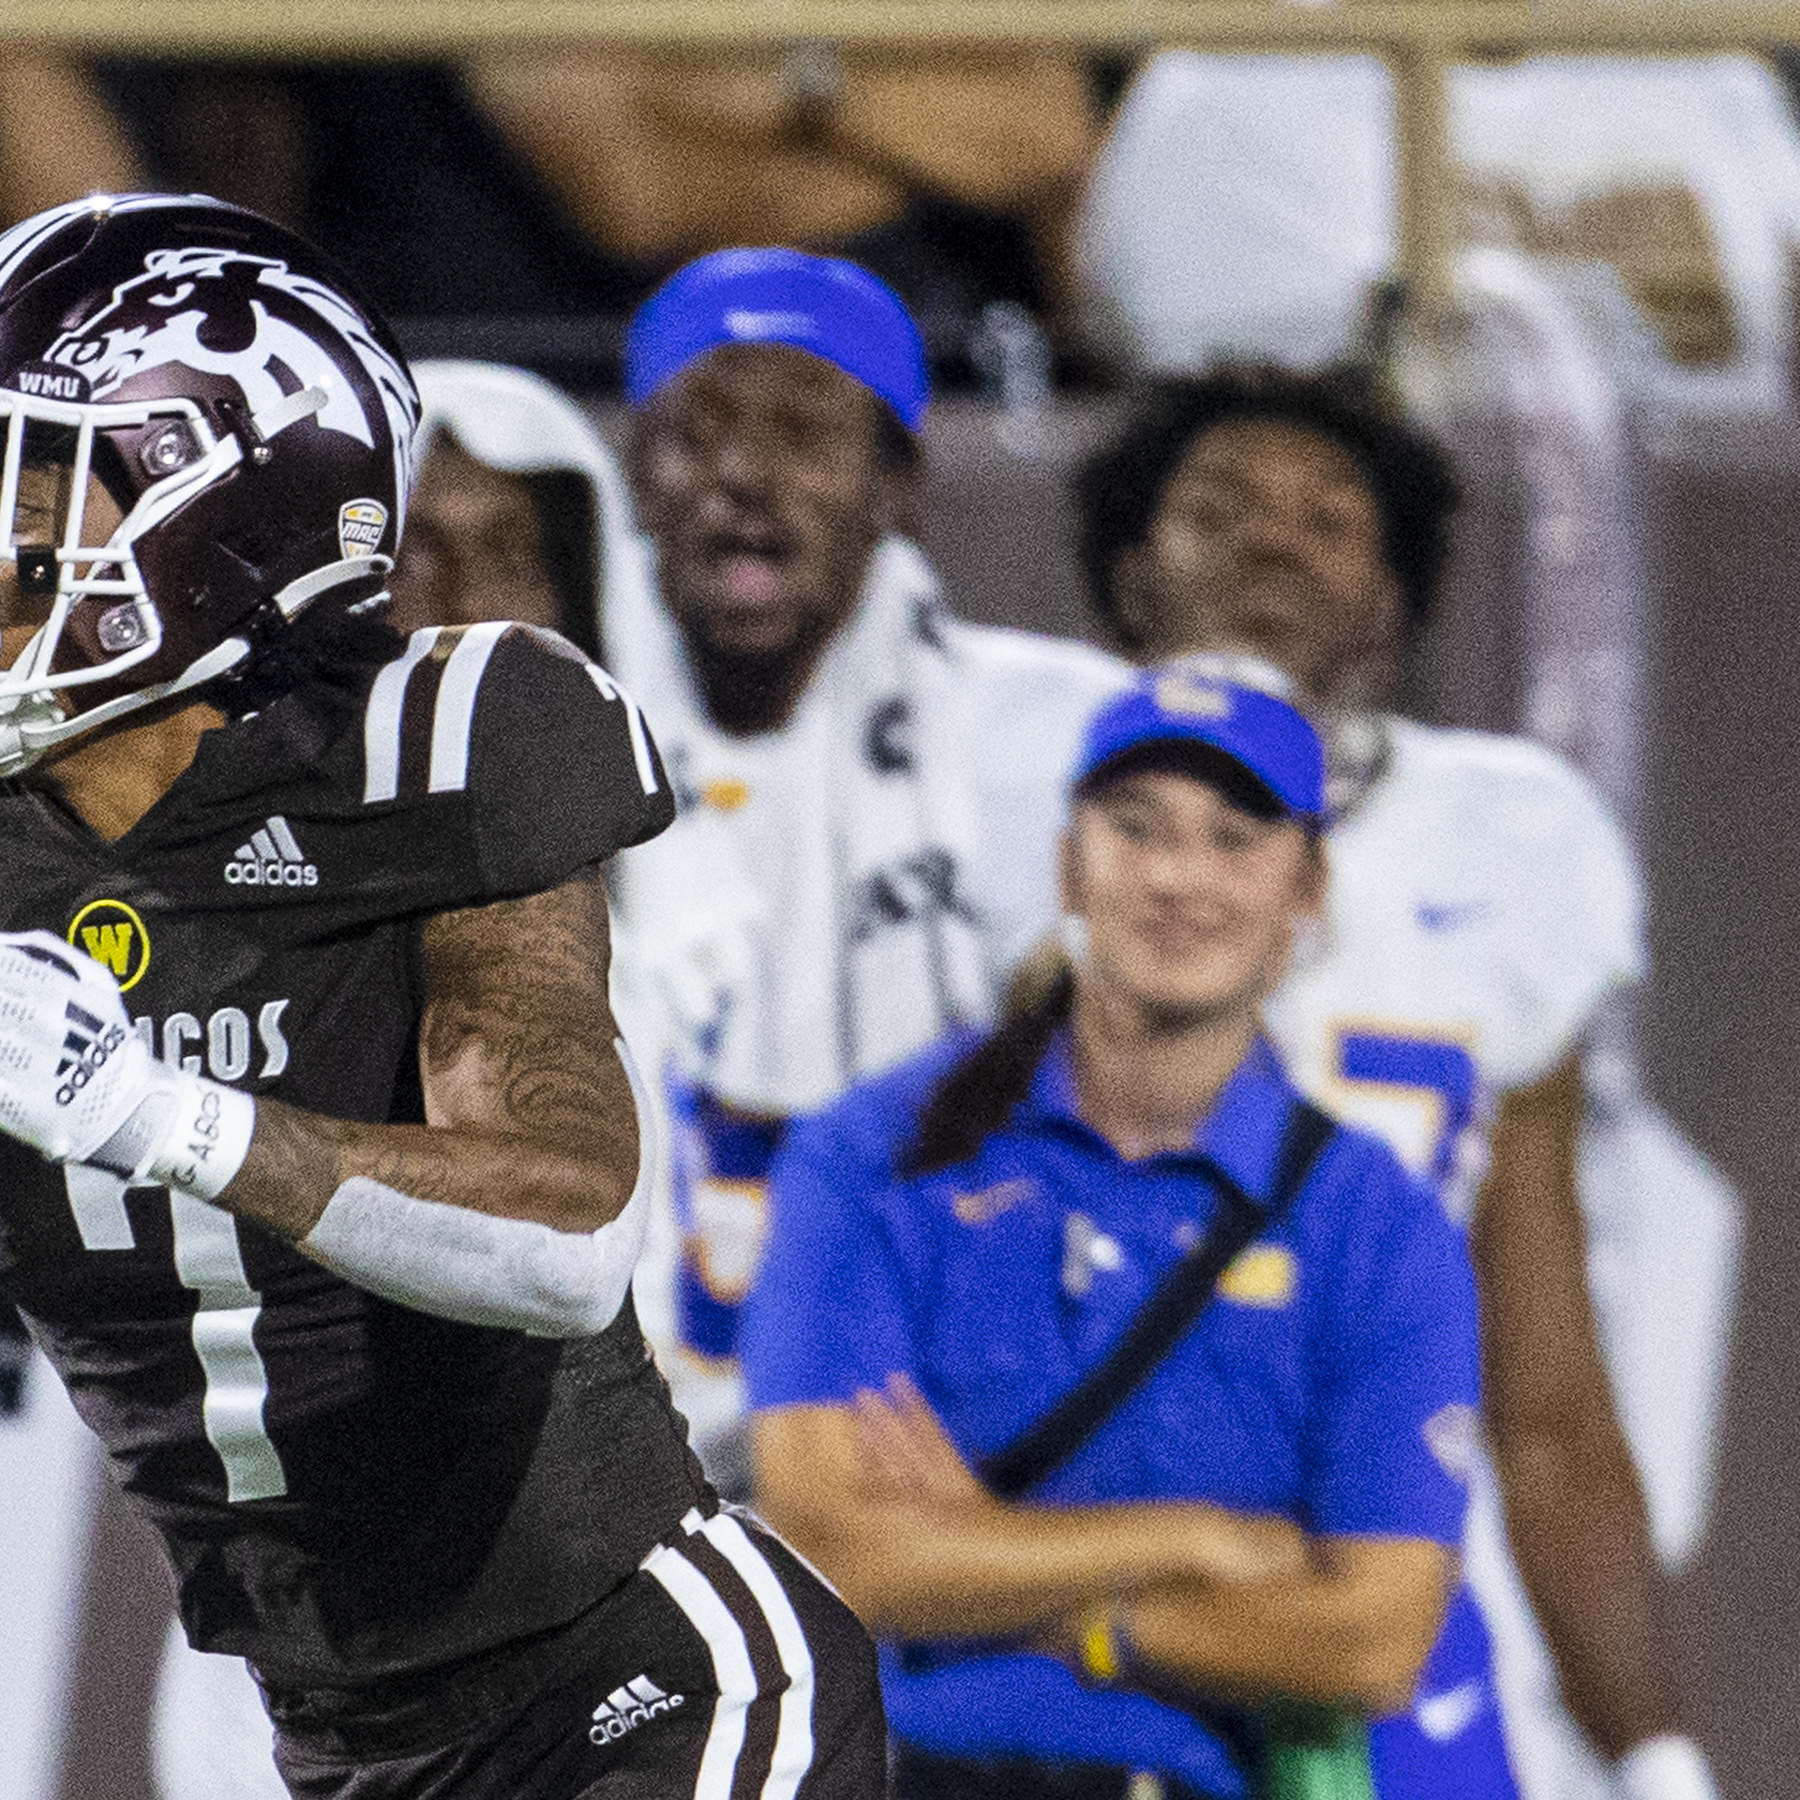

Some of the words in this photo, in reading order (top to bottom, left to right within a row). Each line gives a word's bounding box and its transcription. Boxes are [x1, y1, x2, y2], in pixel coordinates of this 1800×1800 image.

[19, 371, 80, 398] WMU
[224, 859, 319, 887] adidas
[81, 922, 134, 976] W
[55, 1022, 126, 1106] adidas
